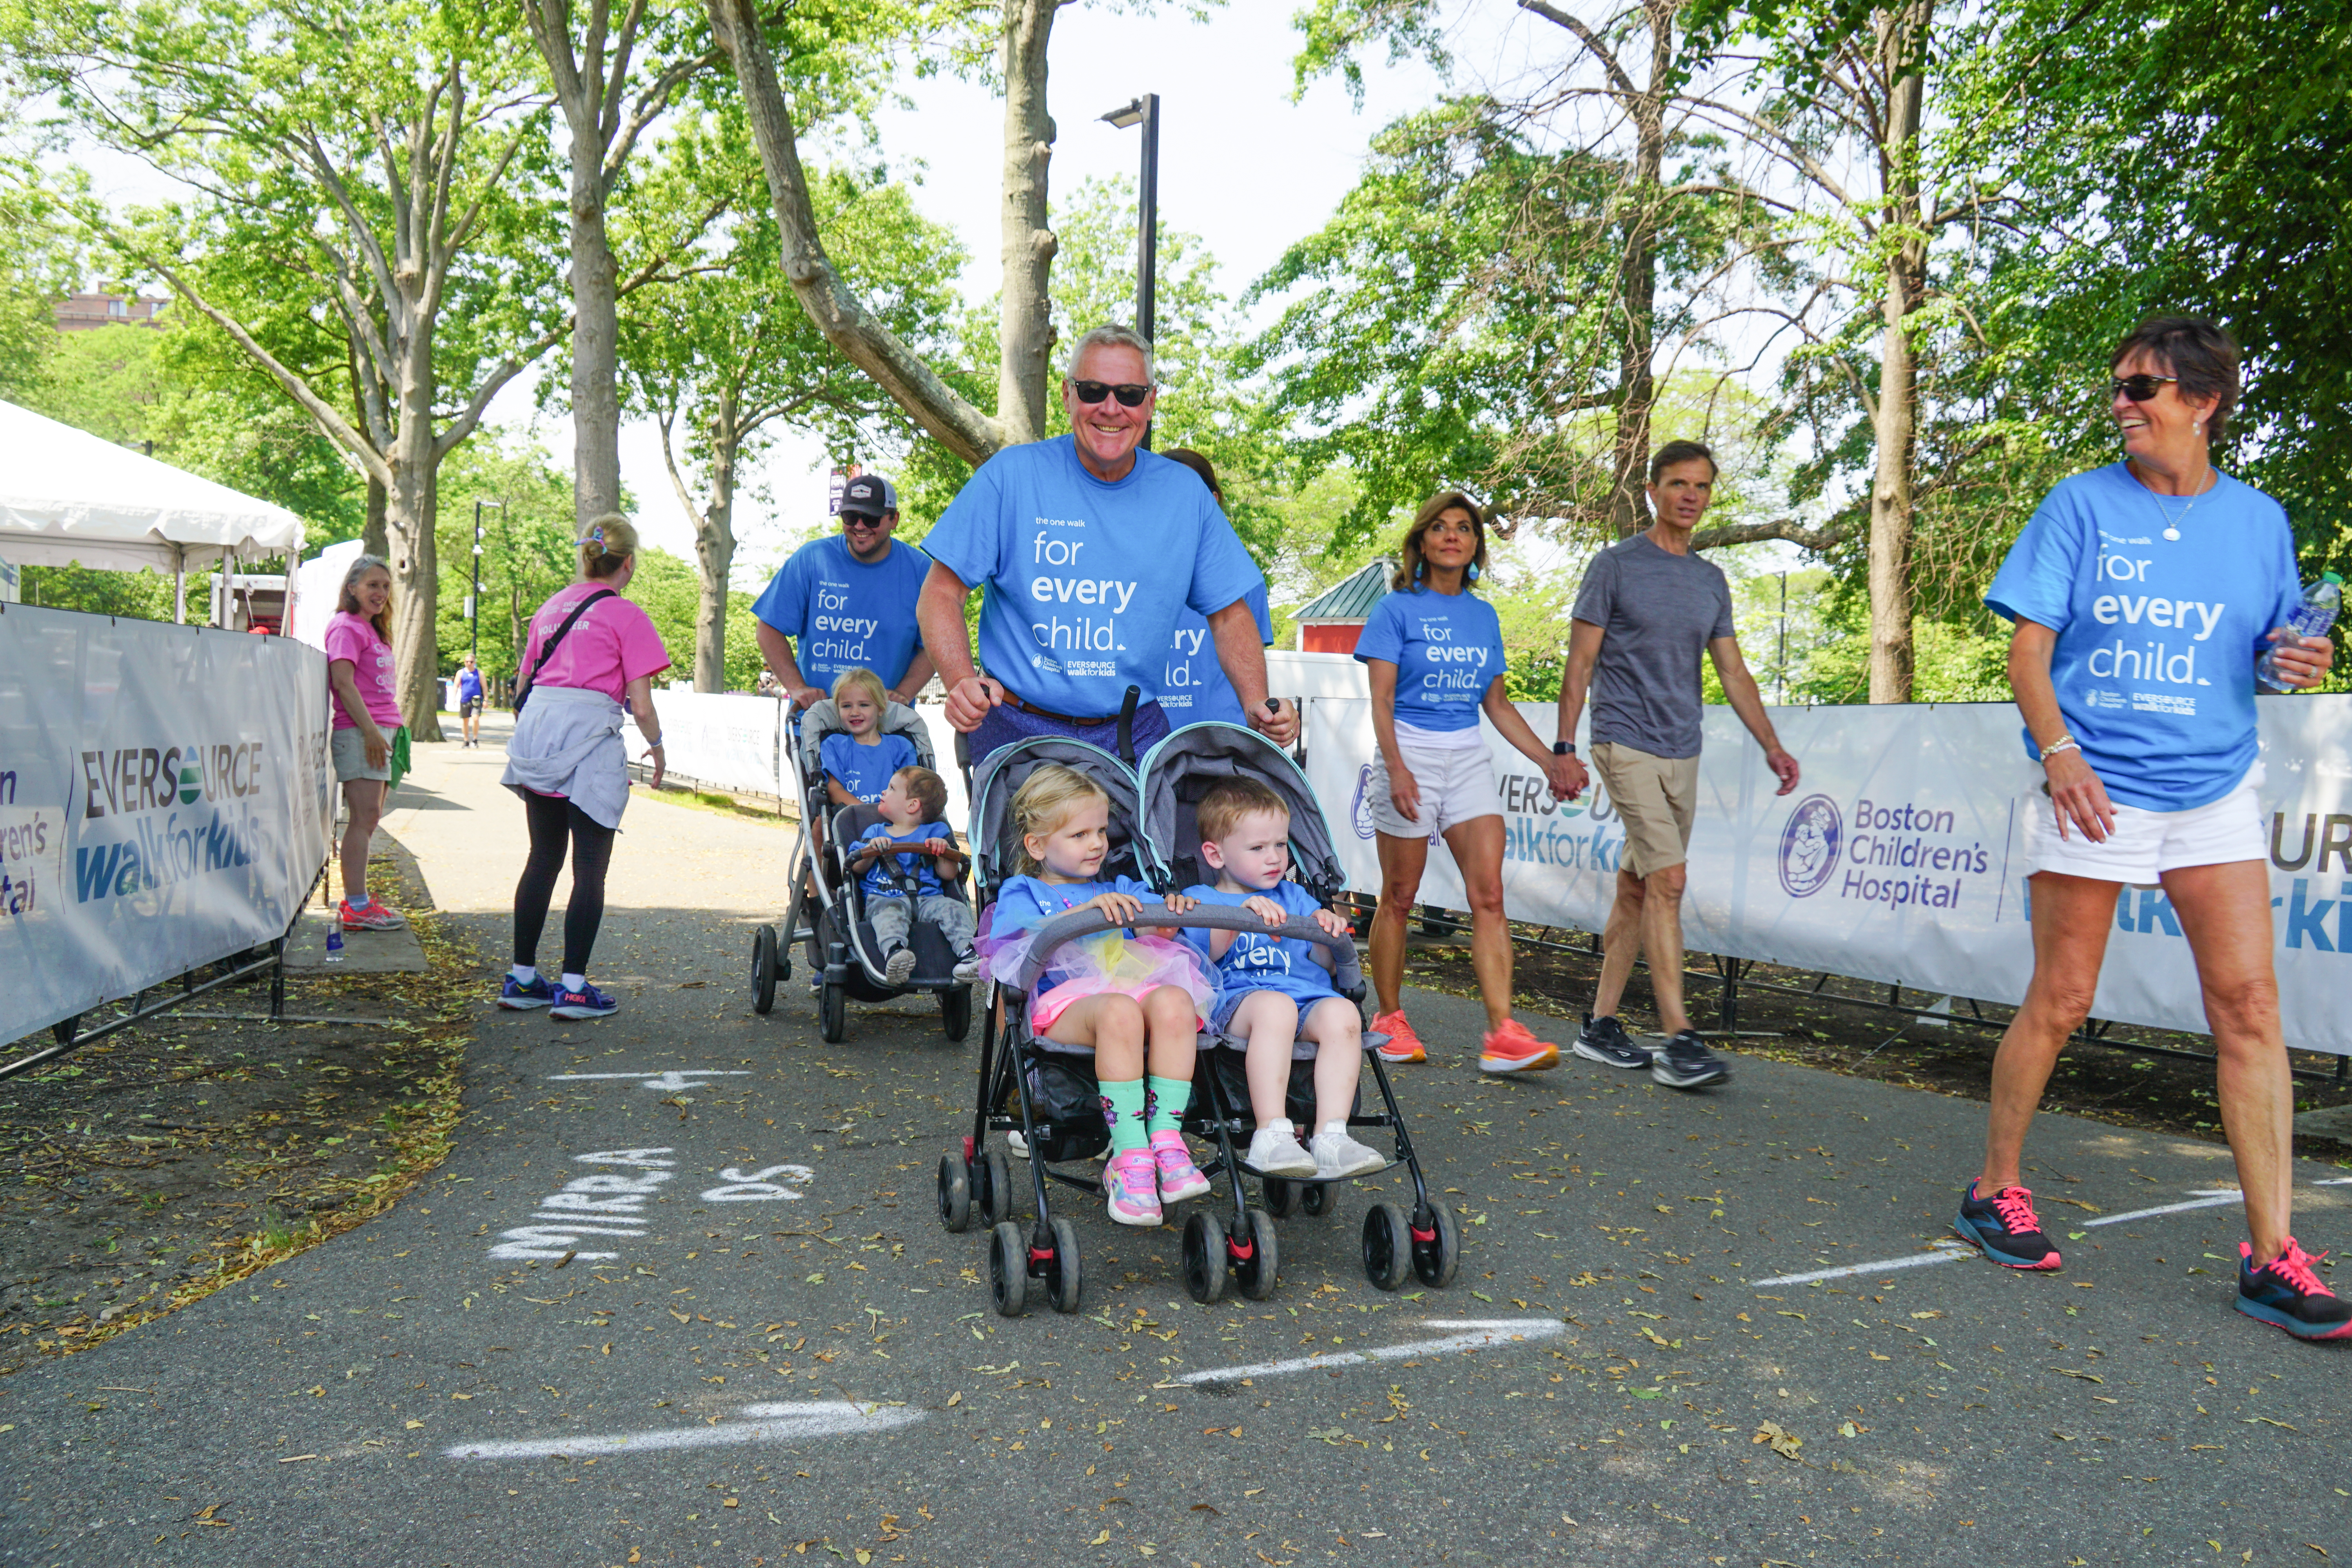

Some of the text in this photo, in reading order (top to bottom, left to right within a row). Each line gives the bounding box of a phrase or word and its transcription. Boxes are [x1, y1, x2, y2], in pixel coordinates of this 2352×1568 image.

[1034, 531, 1083, 566] for
[2127, 536, 2152, 545] walk
[2096, 543, 2152, 582] for
[818, 589, 848, 610] for
[1031, 576, 1137, 614] every
[538, 620, 590, 636] VOLUEER
[815, 615, 878, 639] every
[2093, 595, 2226, 641] every
[1422, 624, 1452, 641] for
[1043, 661, 1063, 670] Children's
[1044, 656, 1057, 664] Boston
[1426, 646, 1488, 668] every
[1042, 665, 1060, 673] Hospital
[1067, 668, 1116, 676] walkforkids
[2132, 692, 2196, 707] EVERSOURCE
[82, 742, 263, 818] EVERSOURCE
[846, 779, 861, 792] or
[1855, 799, 1955, 833] Boston
[76, 802, 261, 904] walkforkids
[1850, 834, 1989, 874] Children's
[1841, 869, 1962, 911] Hospital
[1235, 932, 1258, 953] or
[1222, 945, 1291, 976] very
[564, 993, 586, 1004] HOKA
